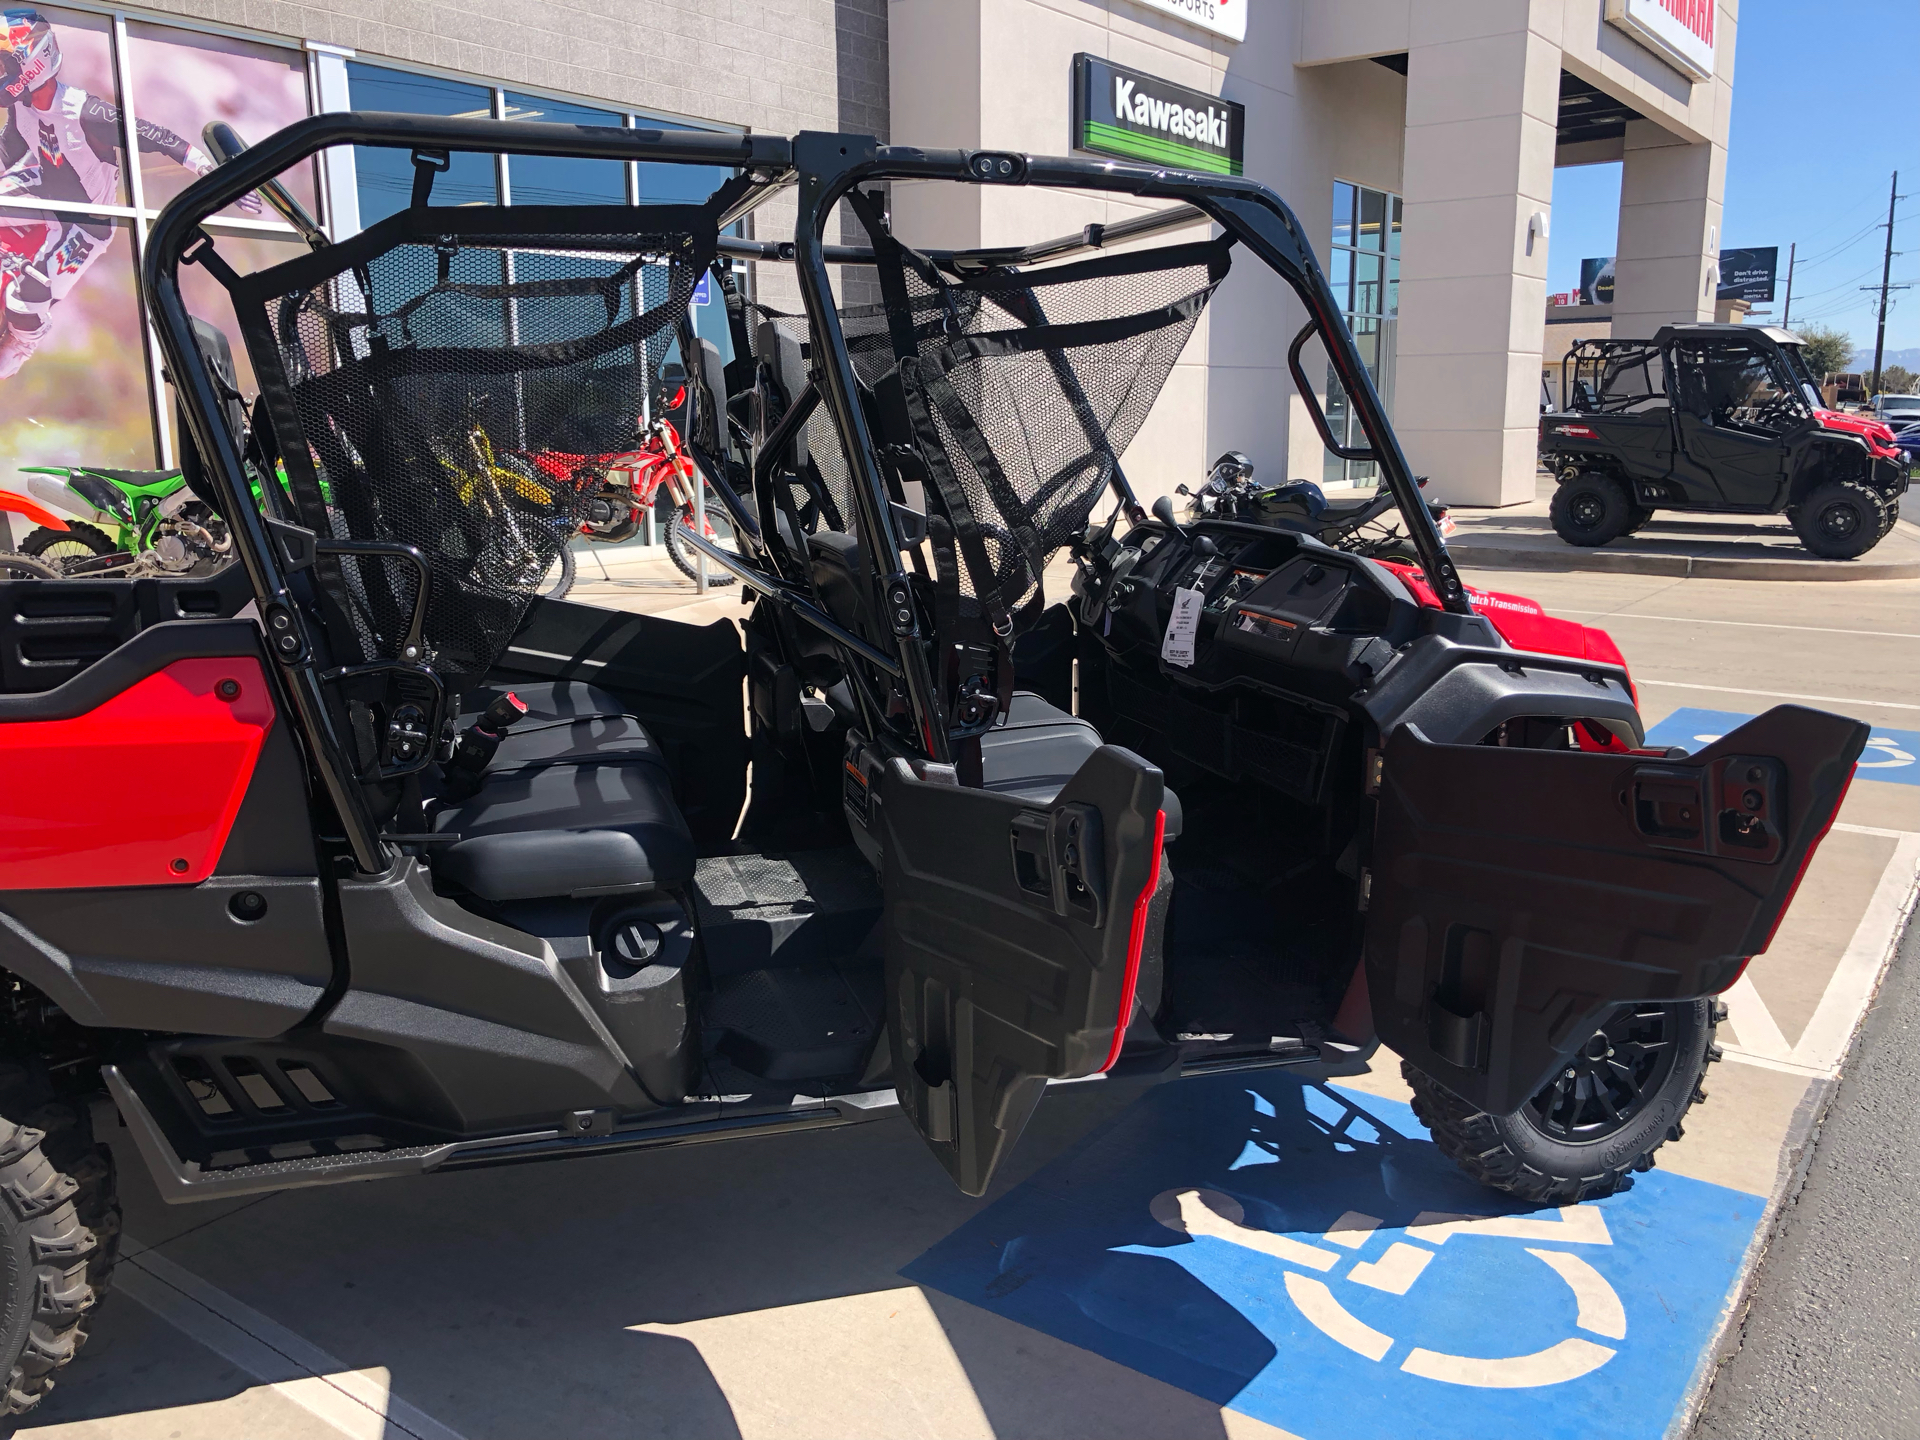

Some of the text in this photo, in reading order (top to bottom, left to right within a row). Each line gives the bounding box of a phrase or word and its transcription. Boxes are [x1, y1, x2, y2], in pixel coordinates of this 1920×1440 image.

[1115, 76, 1227, 148] Kawasaki
[1555, 426, 1590, 434] PIONEER
[1467, 593, 1538, 615] lutch Transmission
